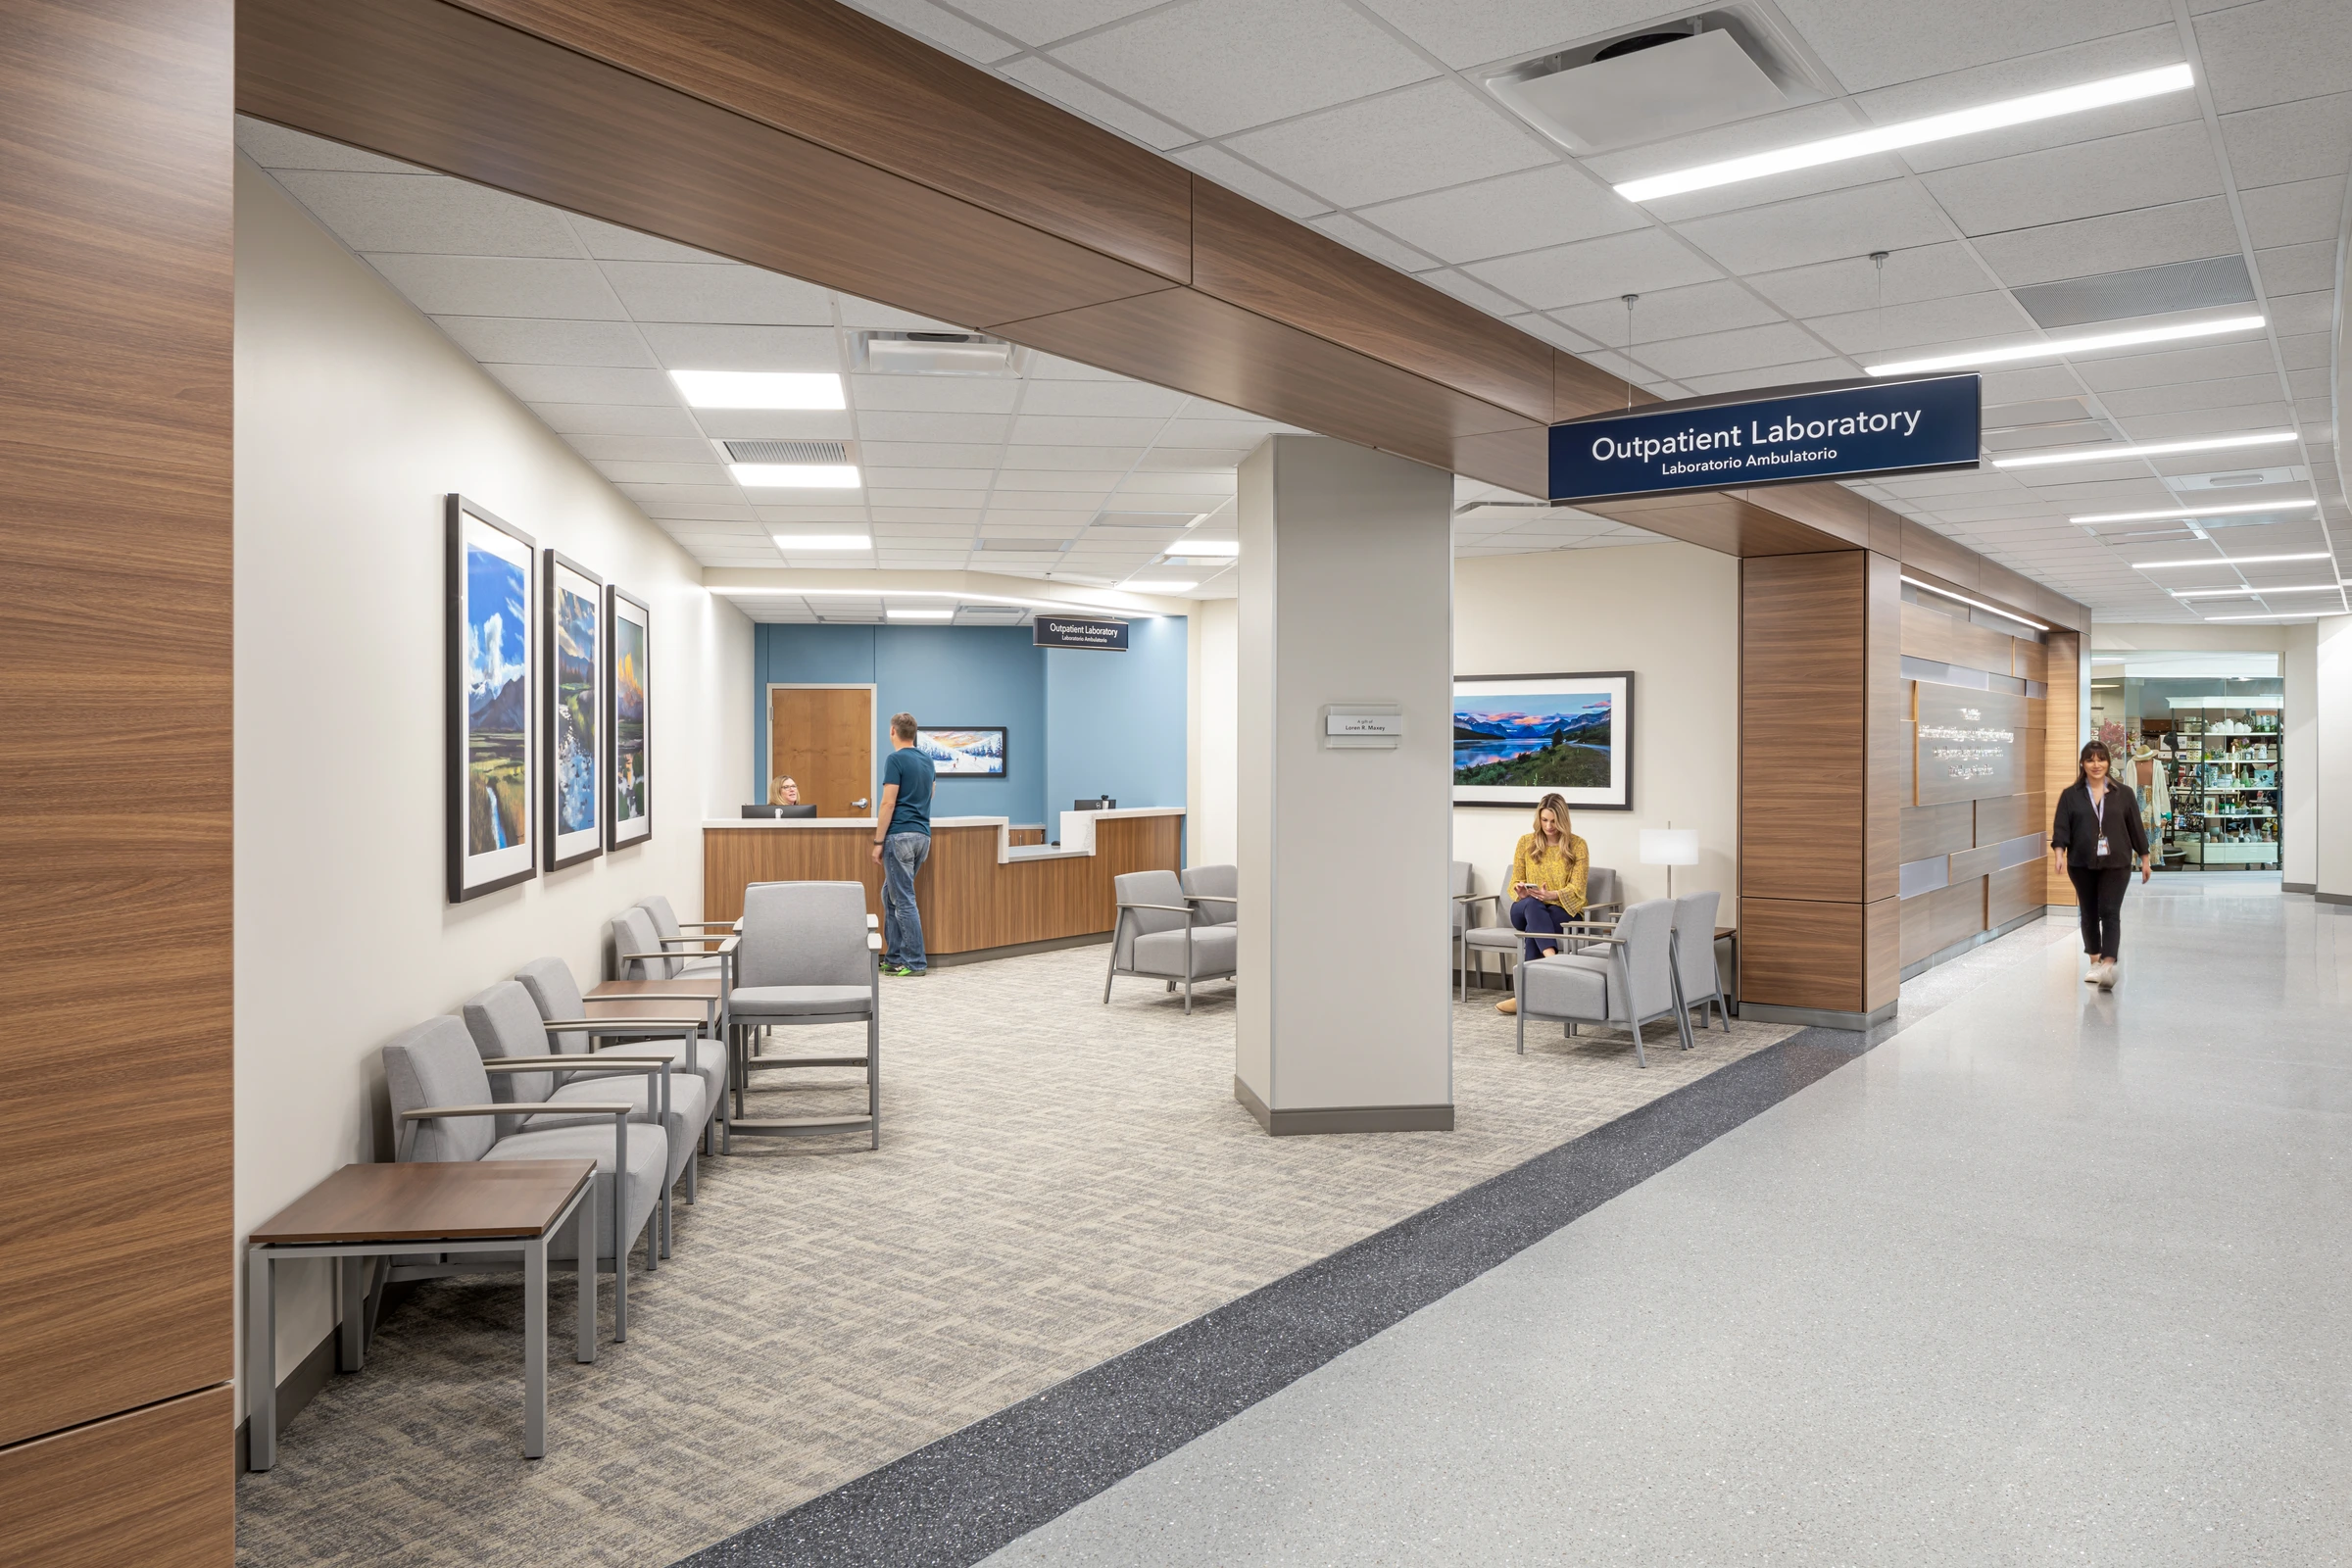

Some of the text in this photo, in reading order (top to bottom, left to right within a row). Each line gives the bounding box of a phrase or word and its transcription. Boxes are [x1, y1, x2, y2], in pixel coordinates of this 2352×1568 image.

[1592, 408, 1922, 464] Outpatient Laboratory
[1661, 446, 1838, 475] Laboratorio Ambulatorio
[1050, 622, 1118, 638] Outpatient Laboratory
